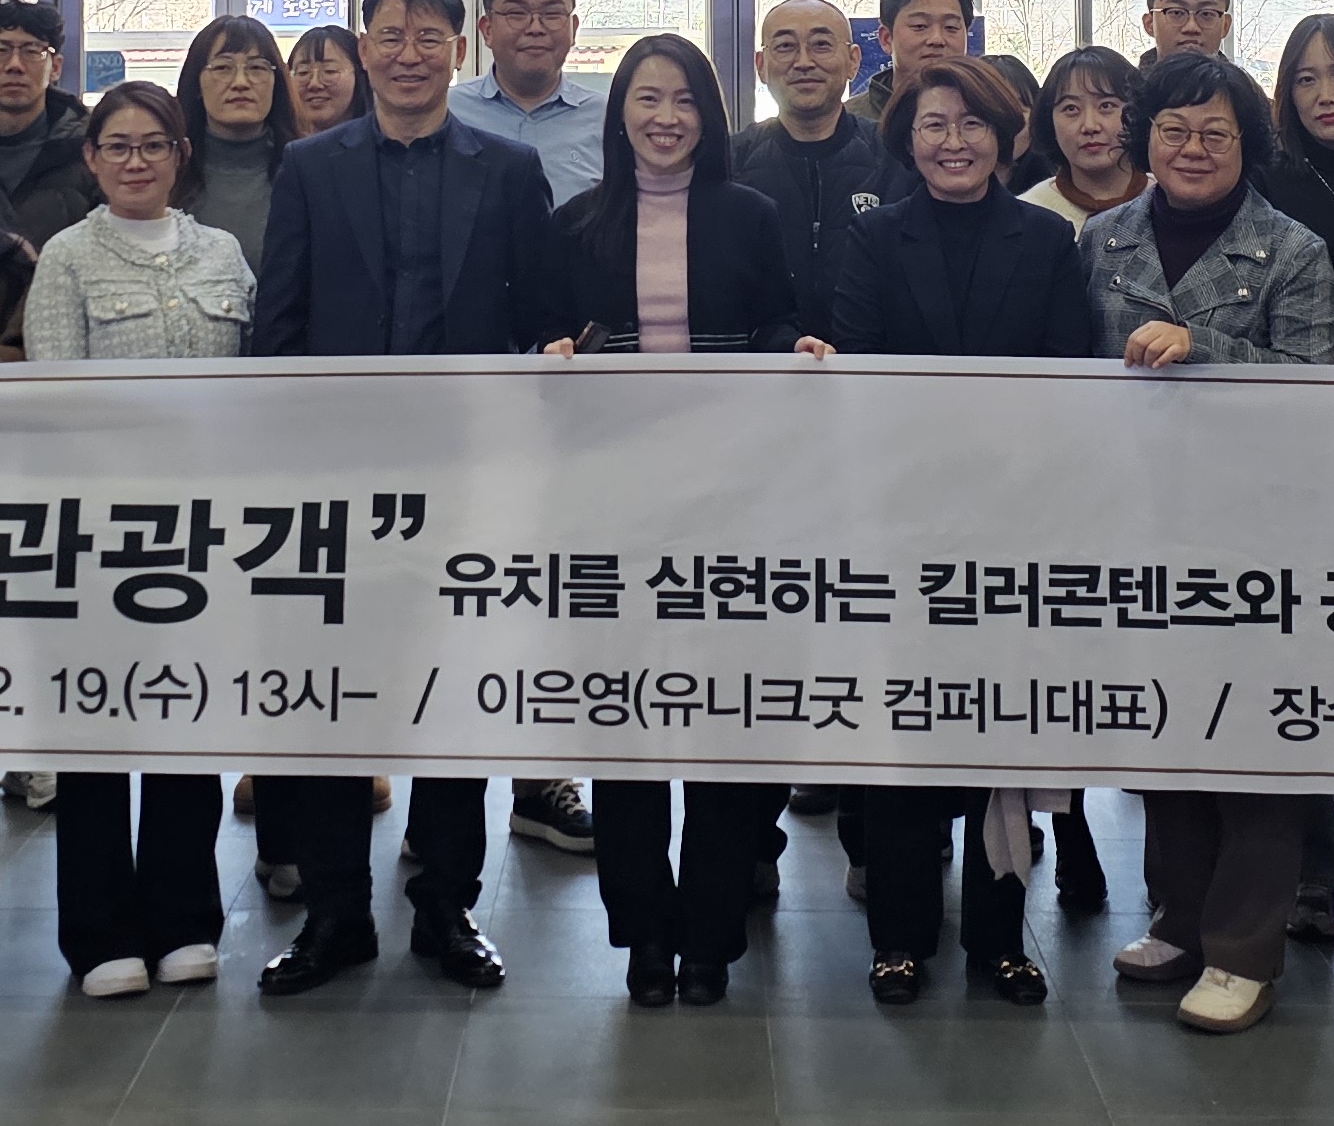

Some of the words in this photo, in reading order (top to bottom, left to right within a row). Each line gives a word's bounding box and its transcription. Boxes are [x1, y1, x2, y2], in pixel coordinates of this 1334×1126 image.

[855, 196, 878, 207] NETS
[439, 553, 626, 619] 유치를
[645, 555, 896, 624] 실현하는
[918, 561, 1302, 634] 킬러콘텐츠와
[51, 661, 209, 723] 19.(수)
[412, 667, 440, 725] /
[478, 668, 864, 731] 이은영(유니크굿
[884, 677, 1168, 740] 컴퍼니대표)
[1205, 683, 1233, 741] /
